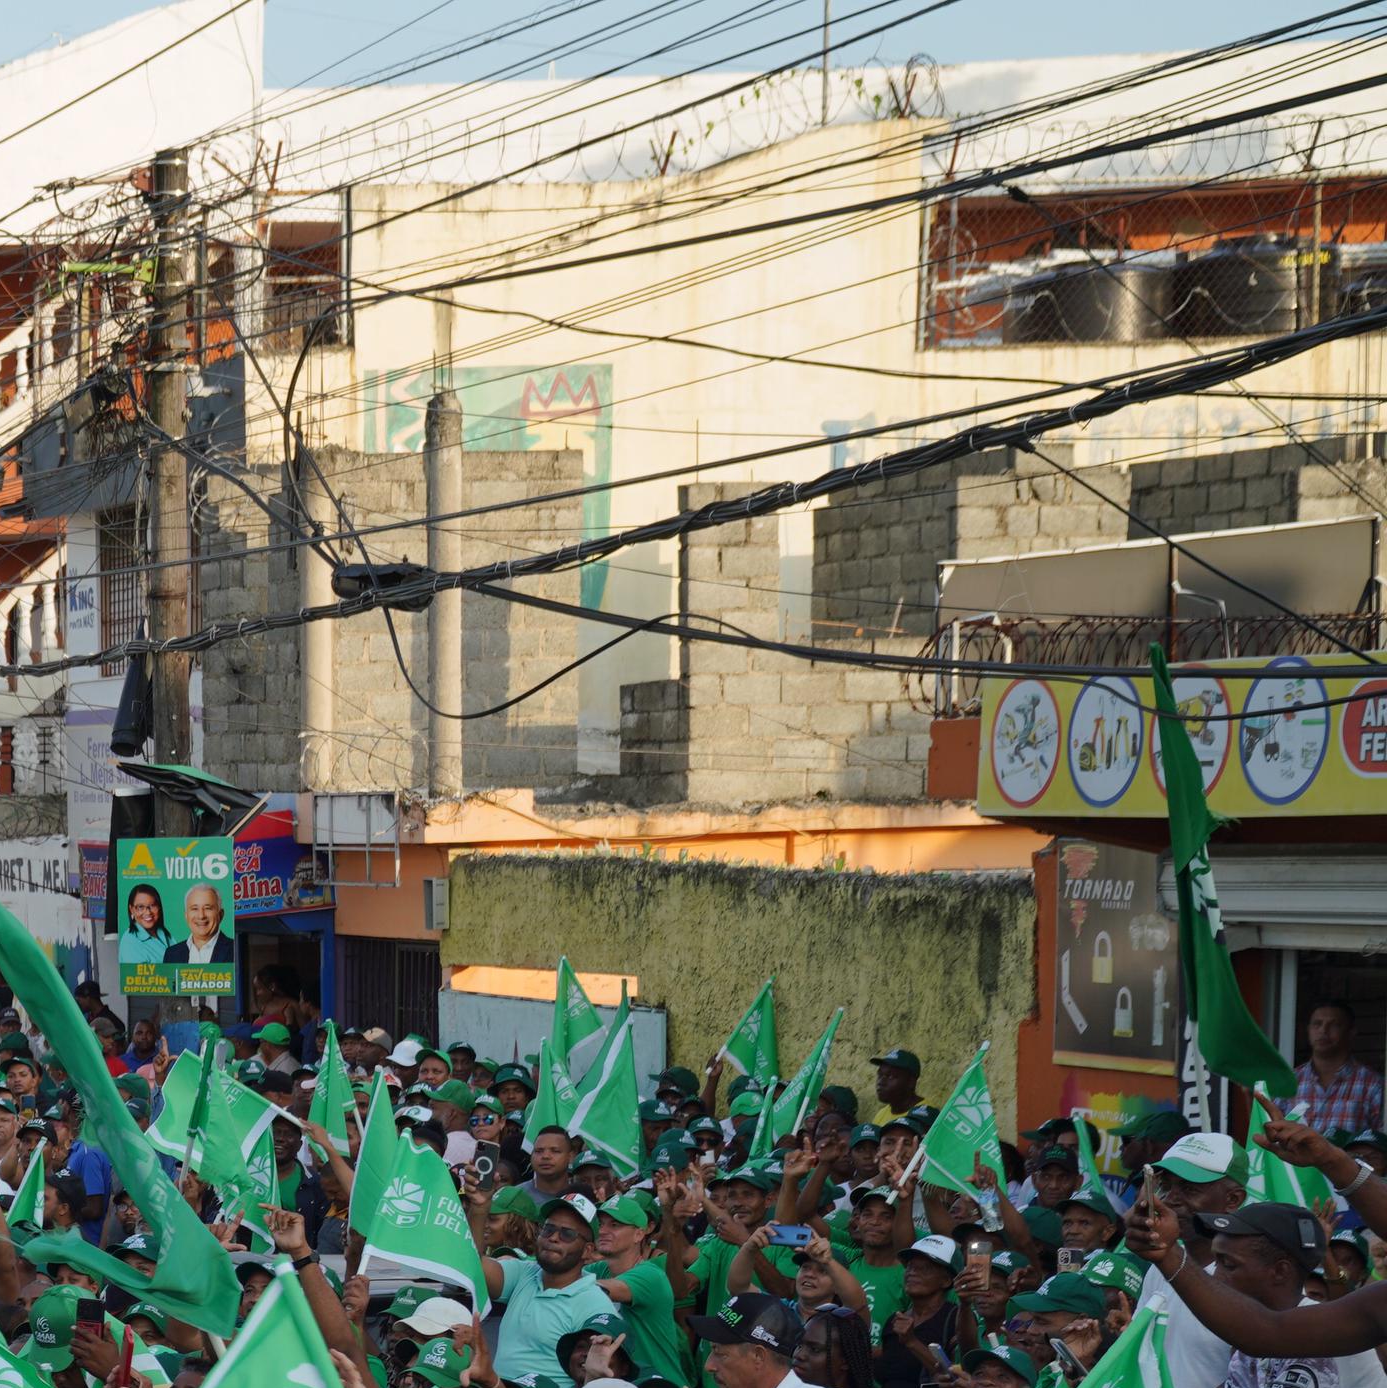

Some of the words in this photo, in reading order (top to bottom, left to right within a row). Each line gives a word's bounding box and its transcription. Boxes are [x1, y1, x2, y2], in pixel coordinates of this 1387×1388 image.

[165, 856, 202, 880] VOTA
[202, 853, 229, 881] 6
[83, 873, 107, 898] BANC
[233, 874, 283, 901] elina
[1063, 879, 1135, 900] TORNADO
[136, 963, 156, 976] ELY
[123, 985, 172, 994] DIPUTADA
[180, 981, 232, 990] SENADOR
[438, 1195, 467, 1223] FUE
